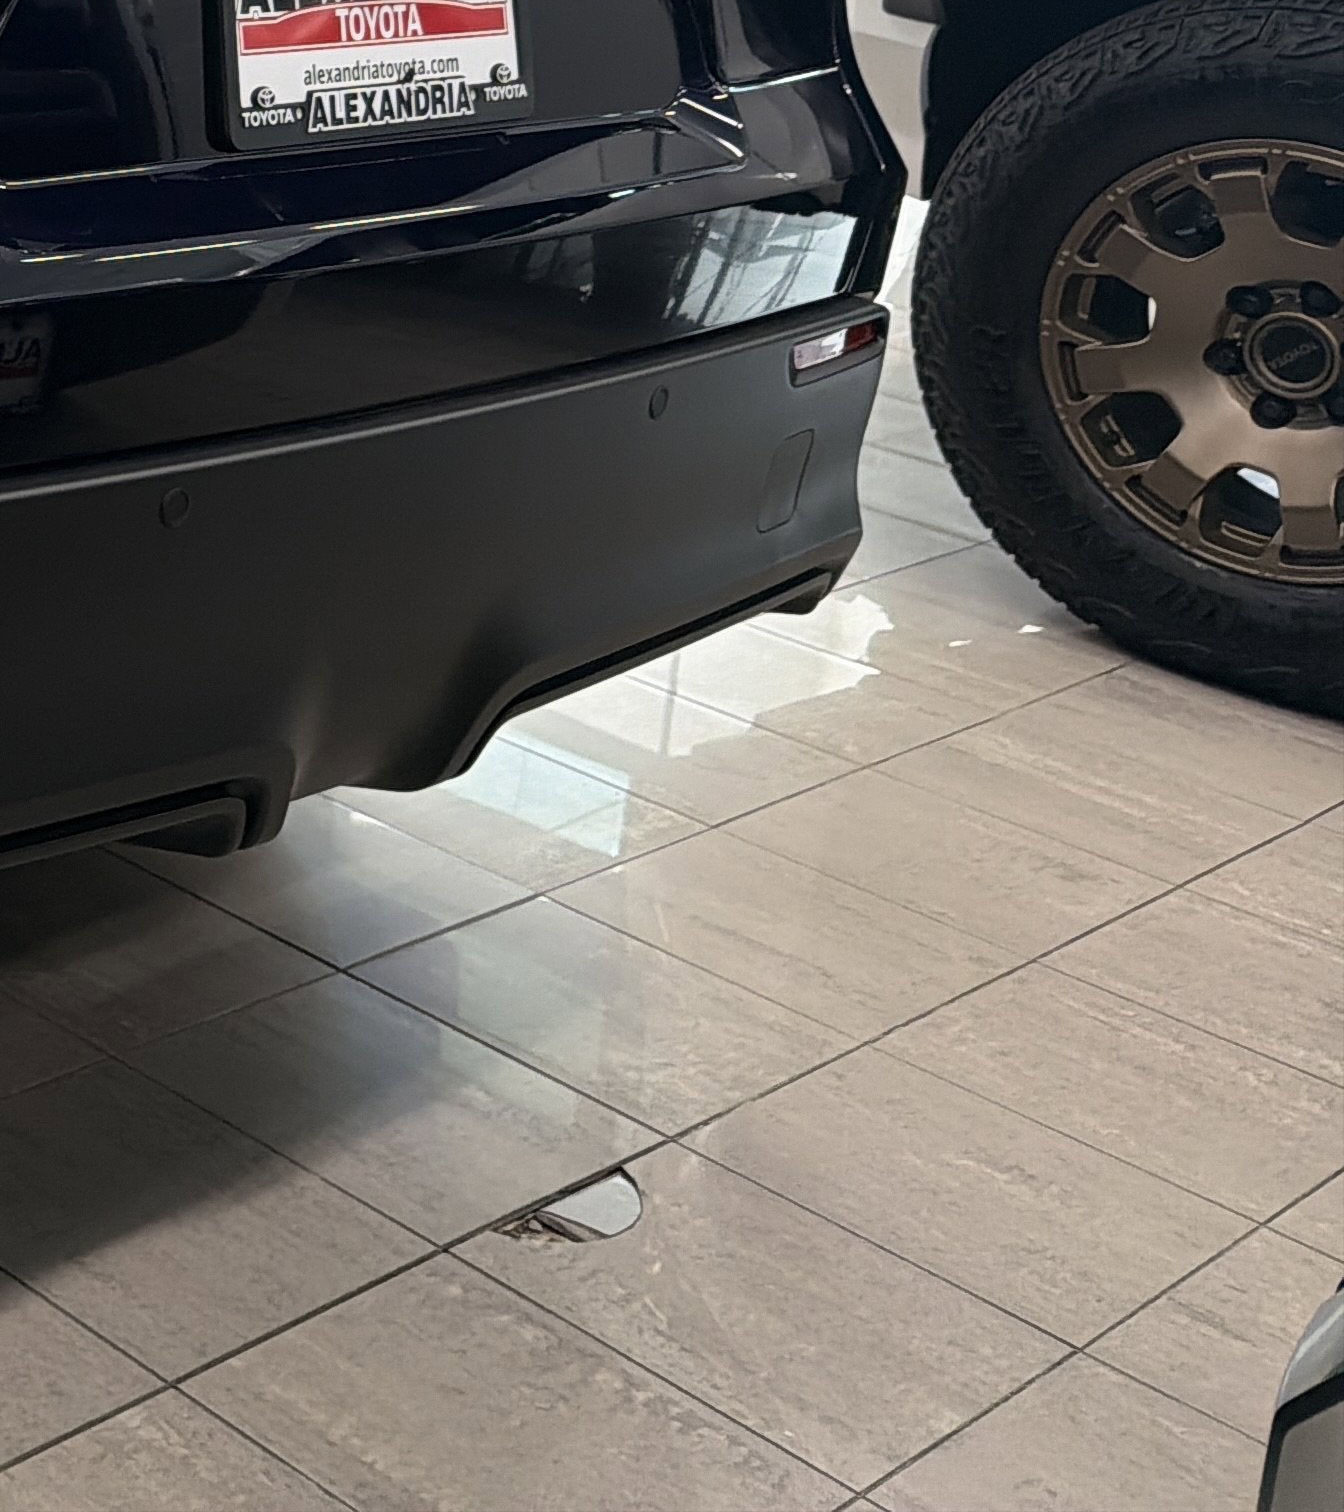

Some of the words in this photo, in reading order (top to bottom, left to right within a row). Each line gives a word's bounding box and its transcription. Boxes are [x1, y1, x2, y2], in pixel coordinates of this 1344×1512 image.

[335, 4, 423, 42] TOYOTA
[303, 56, 459, 86] alexandriatoyota.com
[242, 108, 295, 128] TOYOTA
[310, 85, 474, 130] ALEXANDRIA
[483, 84, 527, 102] TOYOTA
